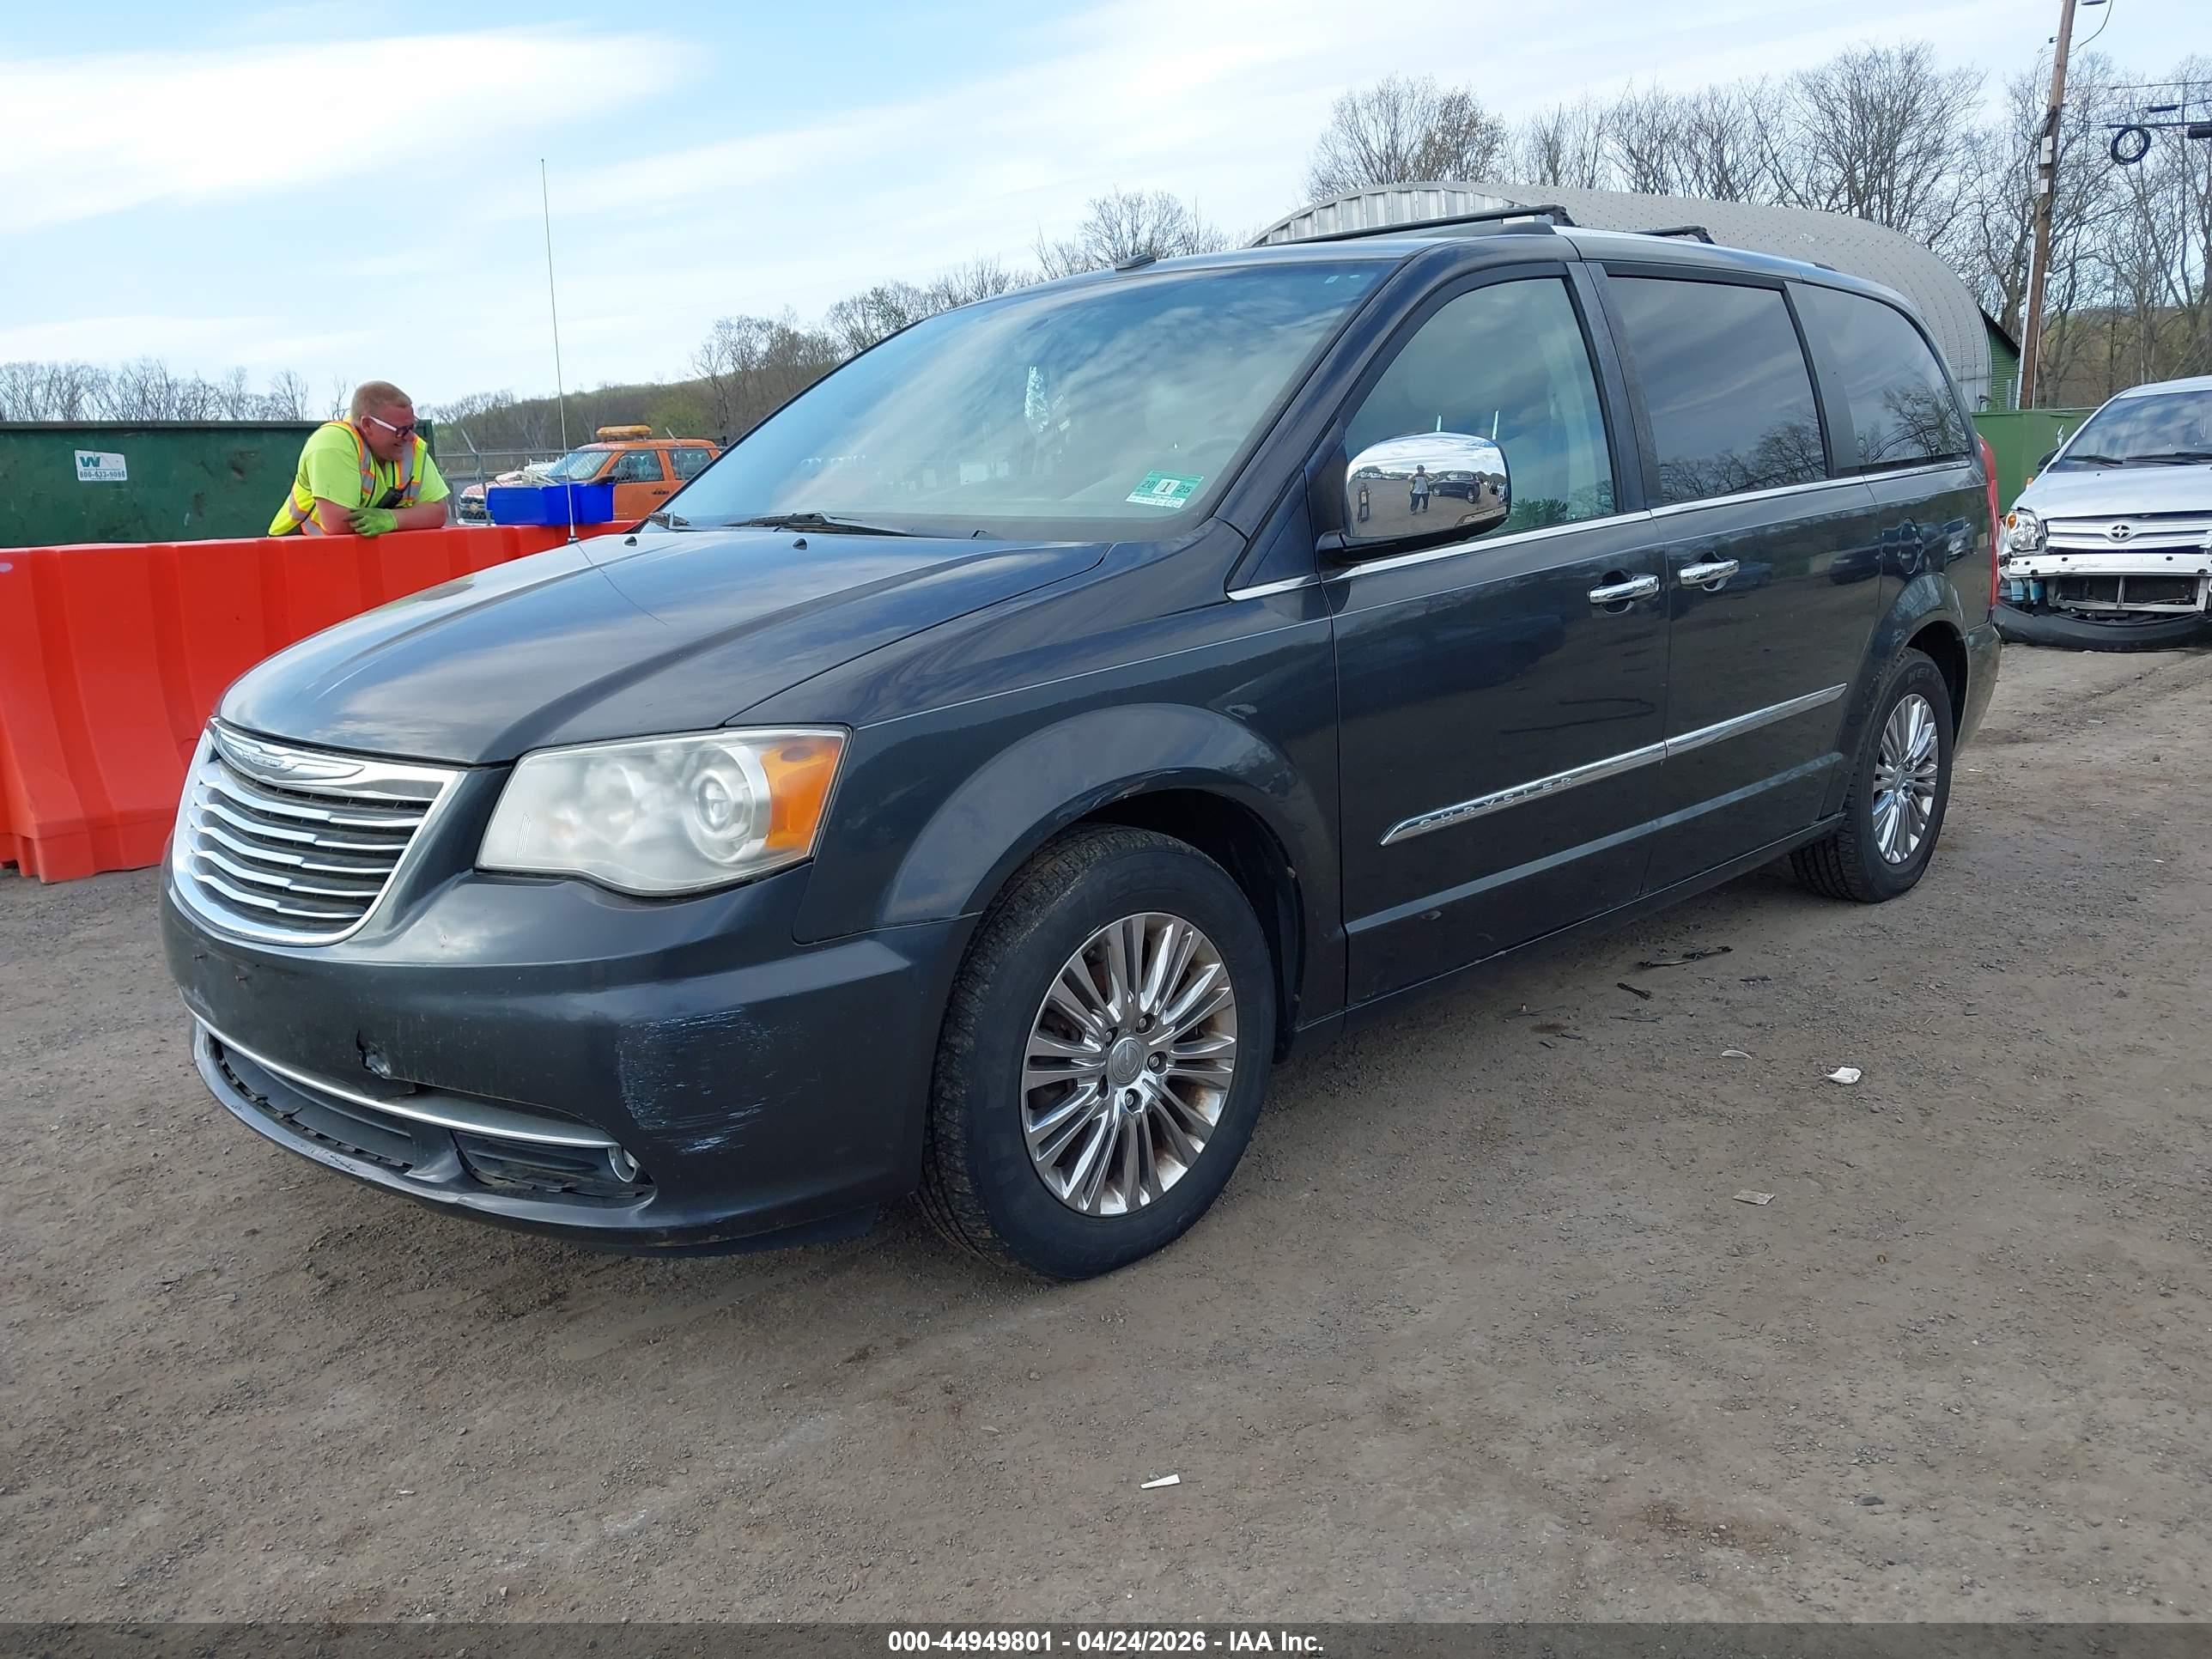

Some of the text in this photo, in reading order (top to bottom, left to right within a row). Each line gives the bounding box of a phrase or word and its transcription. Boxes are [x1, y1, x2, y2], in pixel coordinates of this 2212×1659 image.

[1141, 480, 1156, 489] 20
[1159, 482, 1171, 493] 1
[1419, 777, 1573, 830] CHRYSLER
